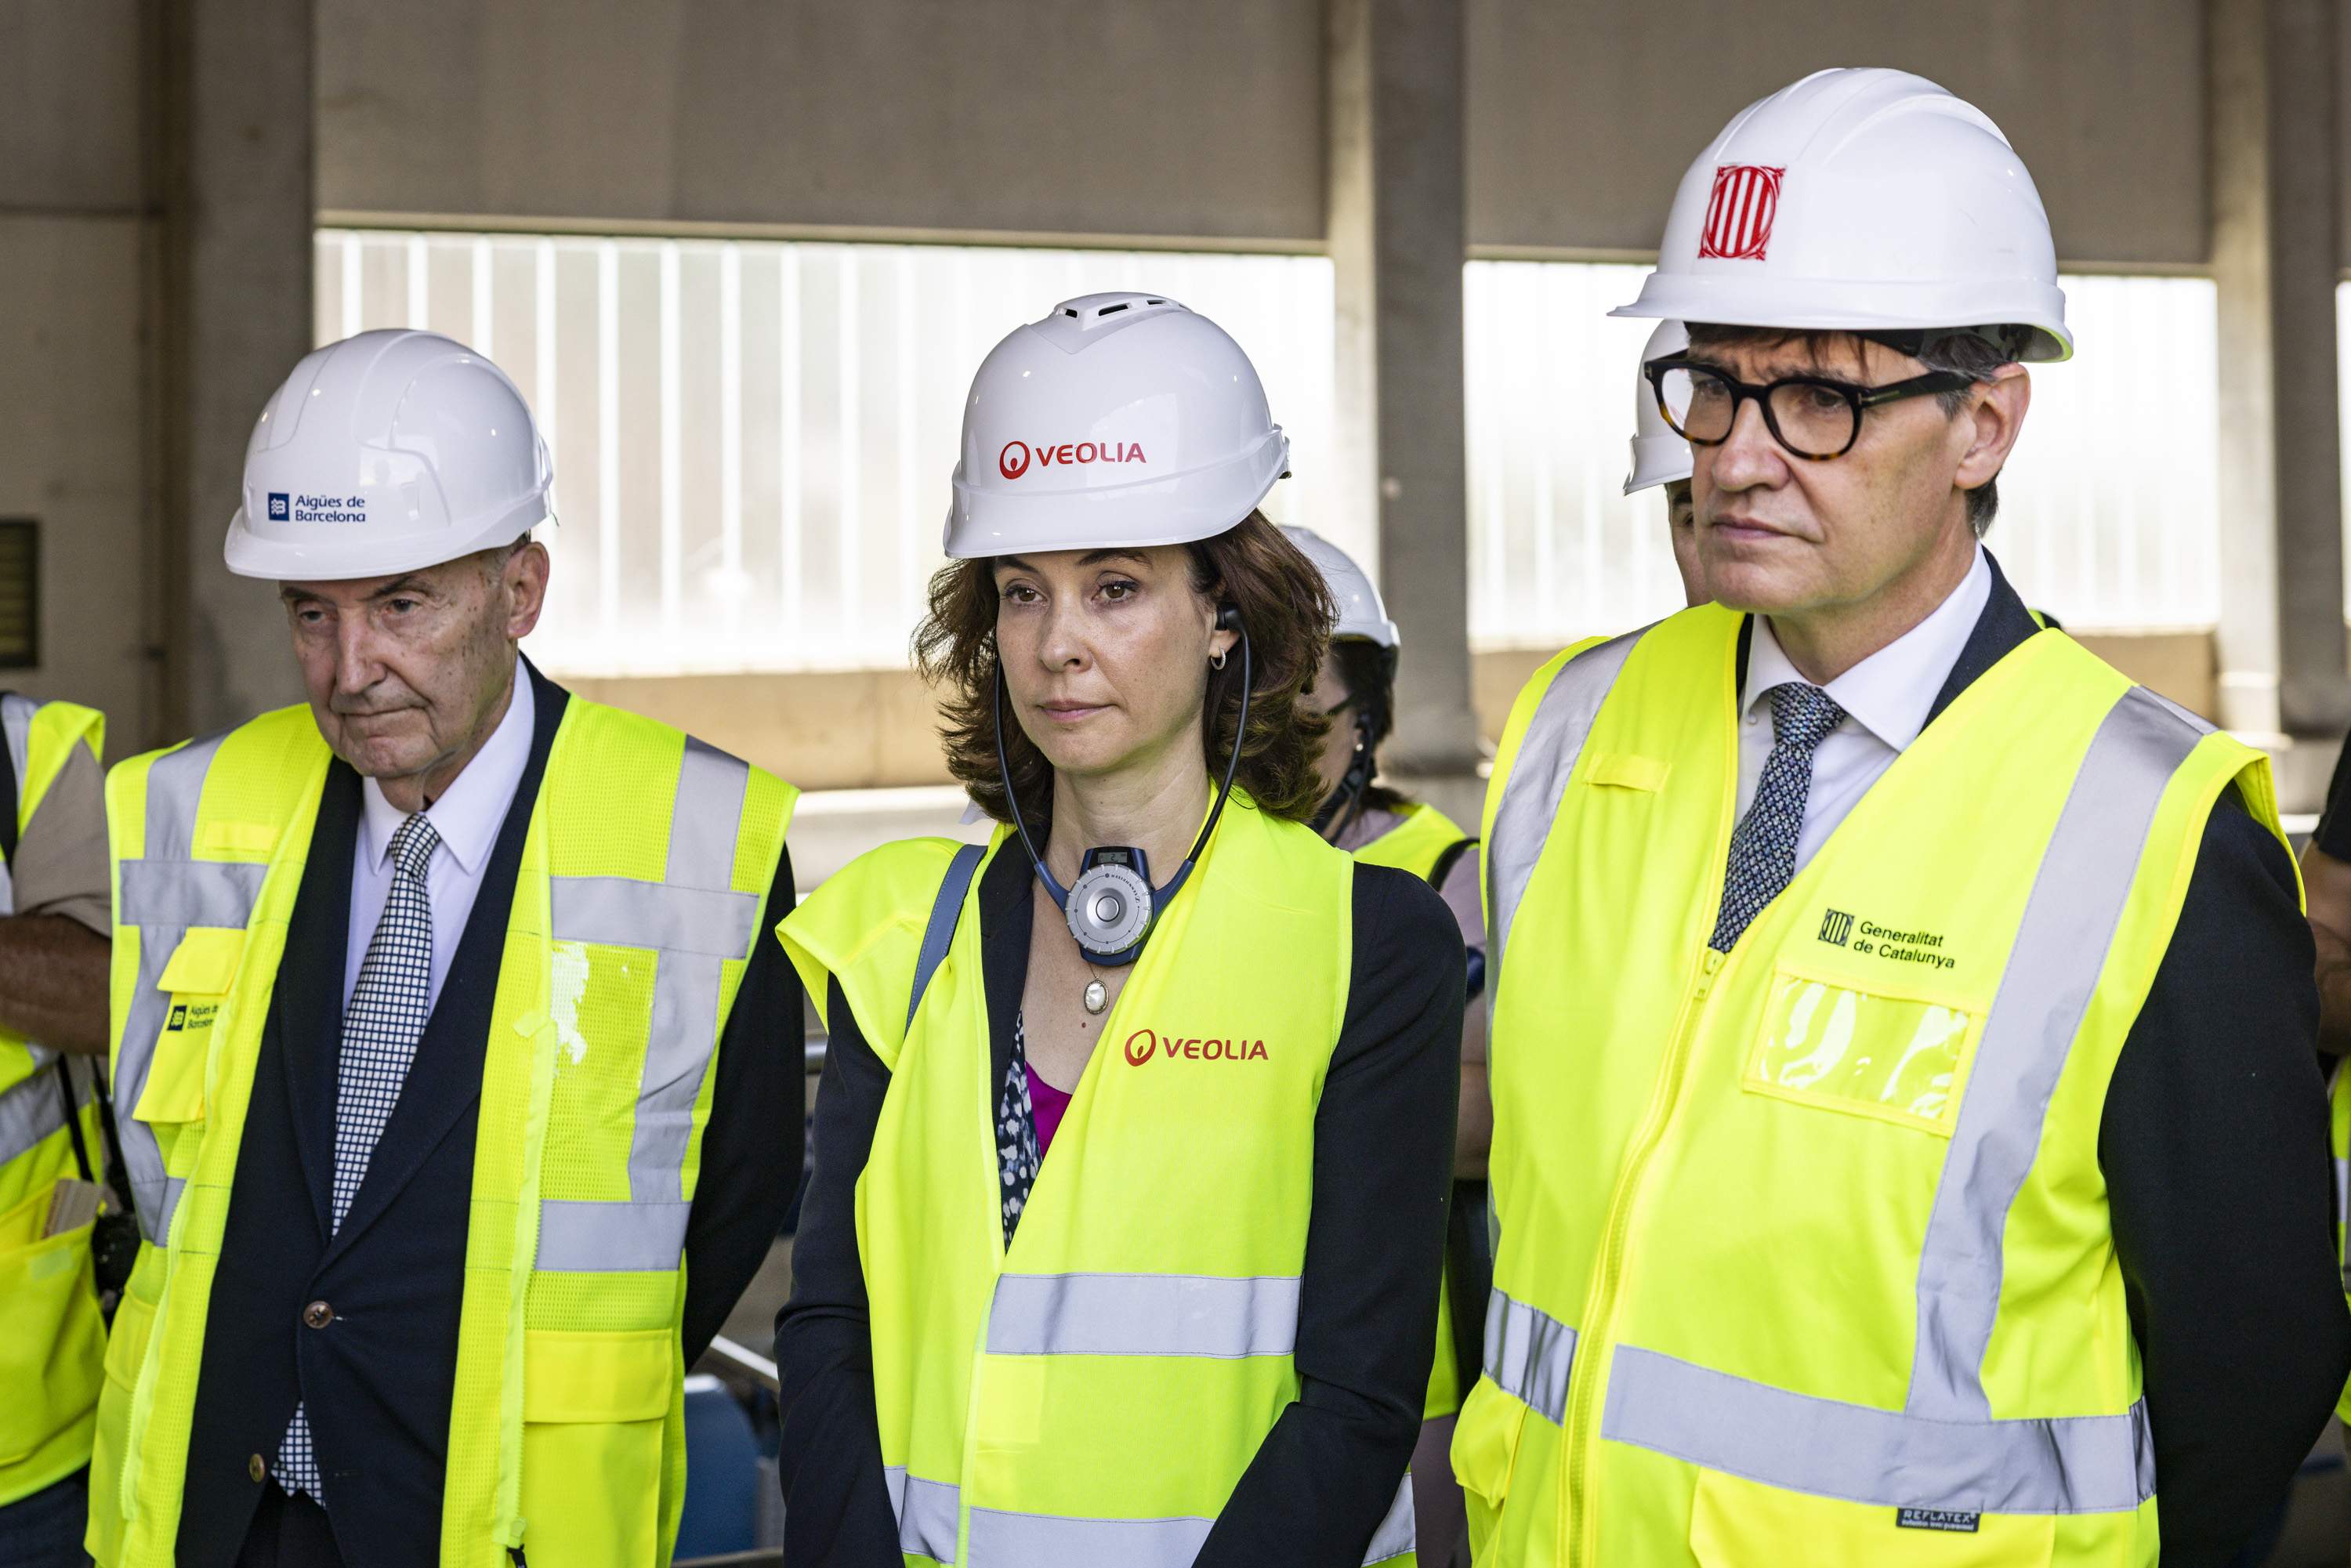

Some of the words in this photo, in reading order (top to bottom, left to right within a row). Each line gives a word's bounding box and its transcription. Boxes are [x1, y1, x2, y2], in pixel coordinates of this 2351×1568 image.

[1035, 442, 1147, 467] VEOLIA
[295, 494, 342, 510] Aigües
[346, 496, 365, 508] de
[295, 509, 366, 523] Barcelona
[1860, 921, 1943, 947] Generalitat
[1853, 939, 1874, 954] de
[1878, 943, 1955, 969] Catalunya
[1162, 1037, 1269, 1060] VEOLIA
